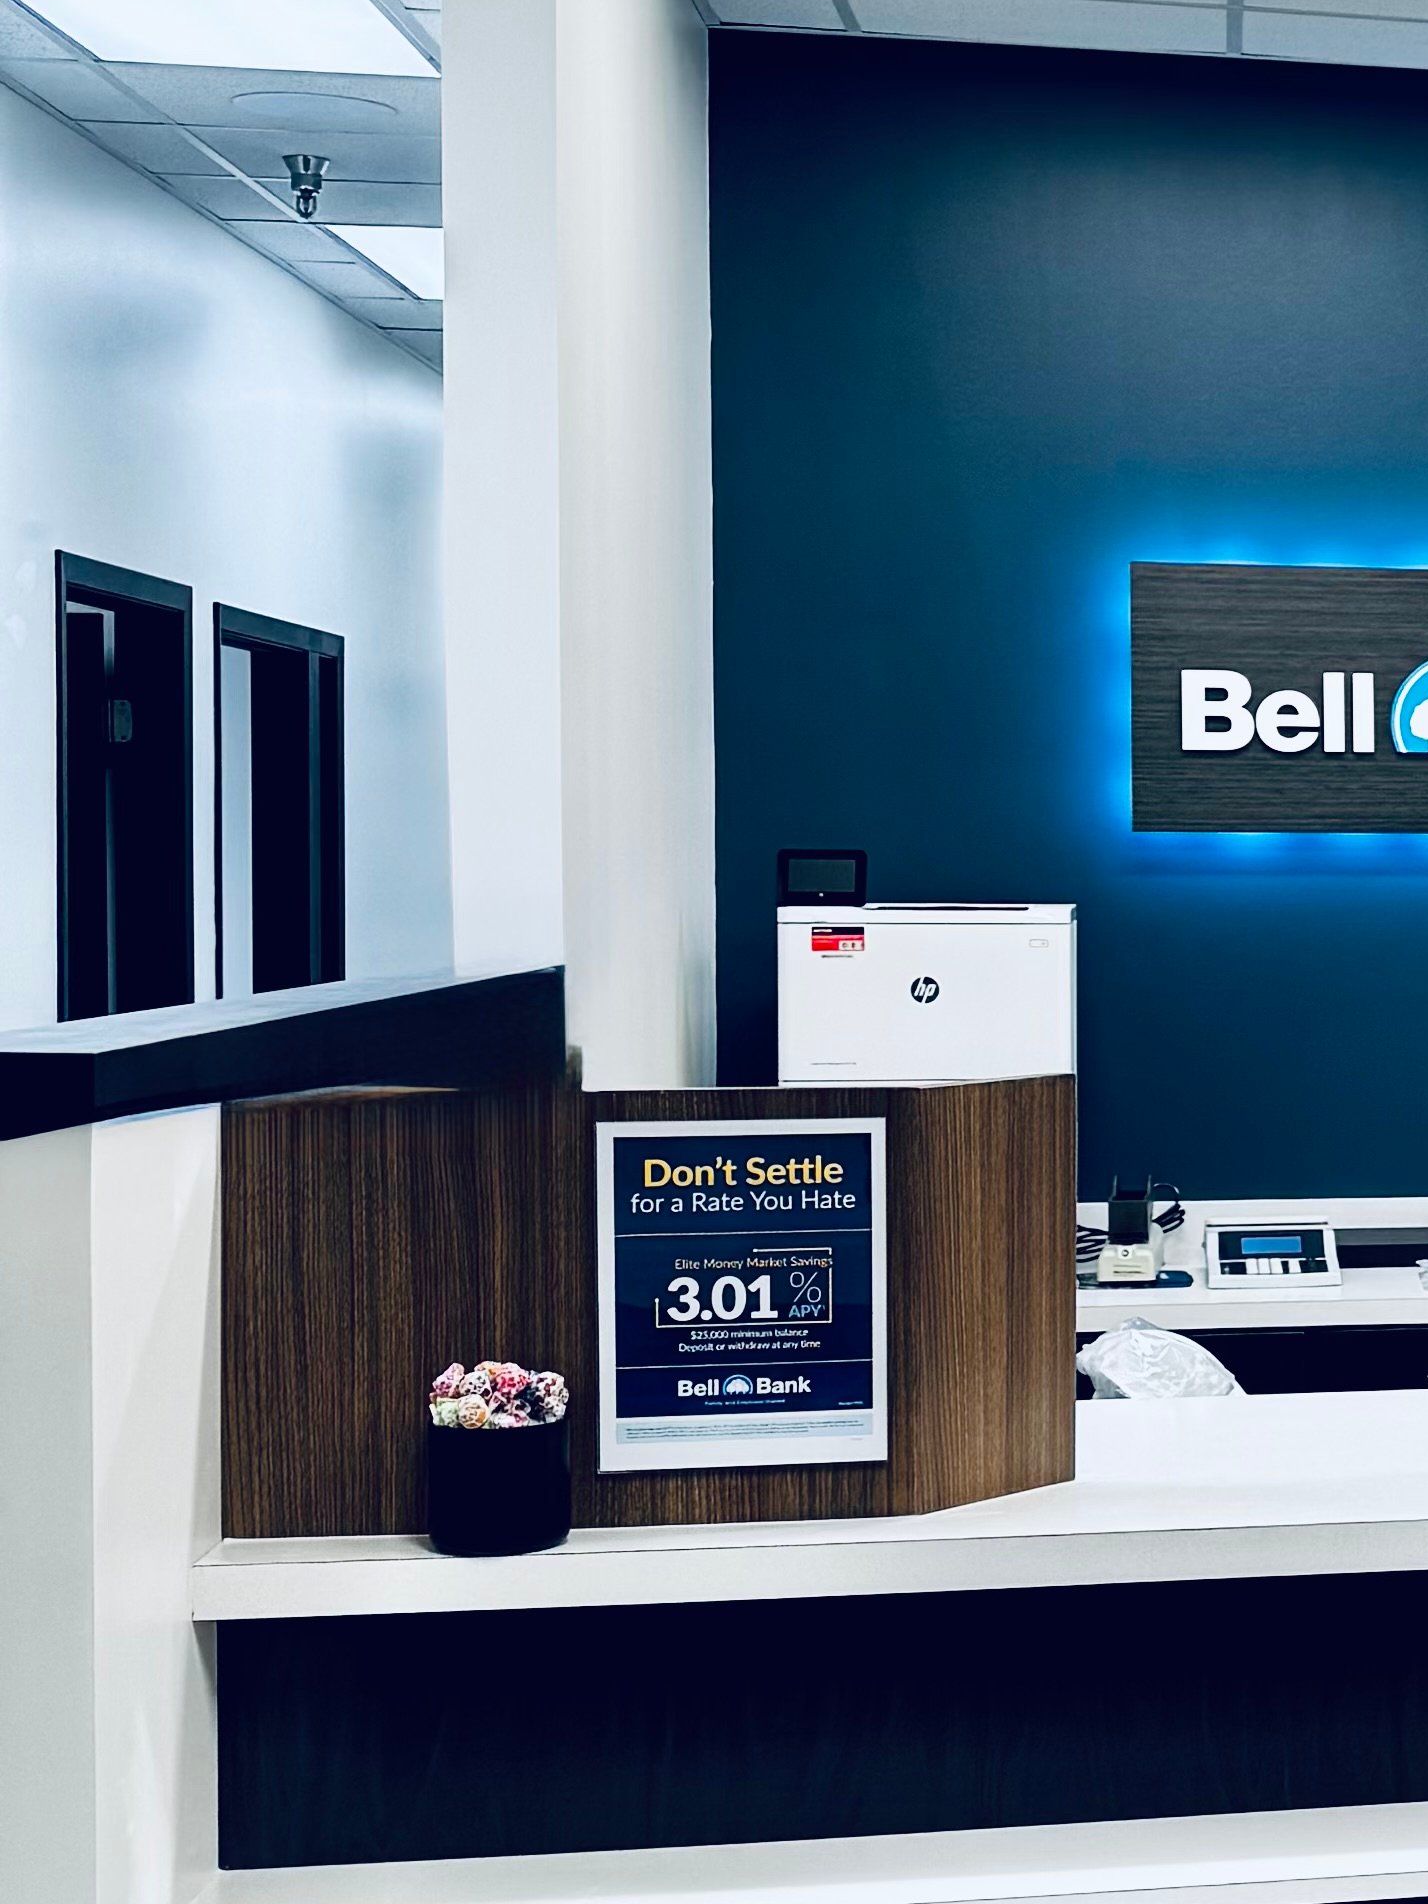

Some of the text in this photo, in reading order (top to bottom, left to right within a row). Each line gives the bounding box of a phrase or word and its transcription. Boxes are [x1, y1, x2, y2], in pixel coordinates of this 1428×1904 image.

[1181, 669, 1375, 754] Bell
[912, 976, 939, 1003] hp
[644, 1155, 843, 1187] Don't Settle
[630, 1190, 856, 1213] for a Rate You Hate
[675, 1256, 833, 1271] Elite Money Market Savings
[667, 1274, 778, 1322] 3.01
[731, 1328, 772, 1339] minimum
[774, 1328, 809, 1338] balance
[679, 1339, 821, 1353] Deposit or withdraw at any time
[677, 1376, 812, 1397] Bell Bank
